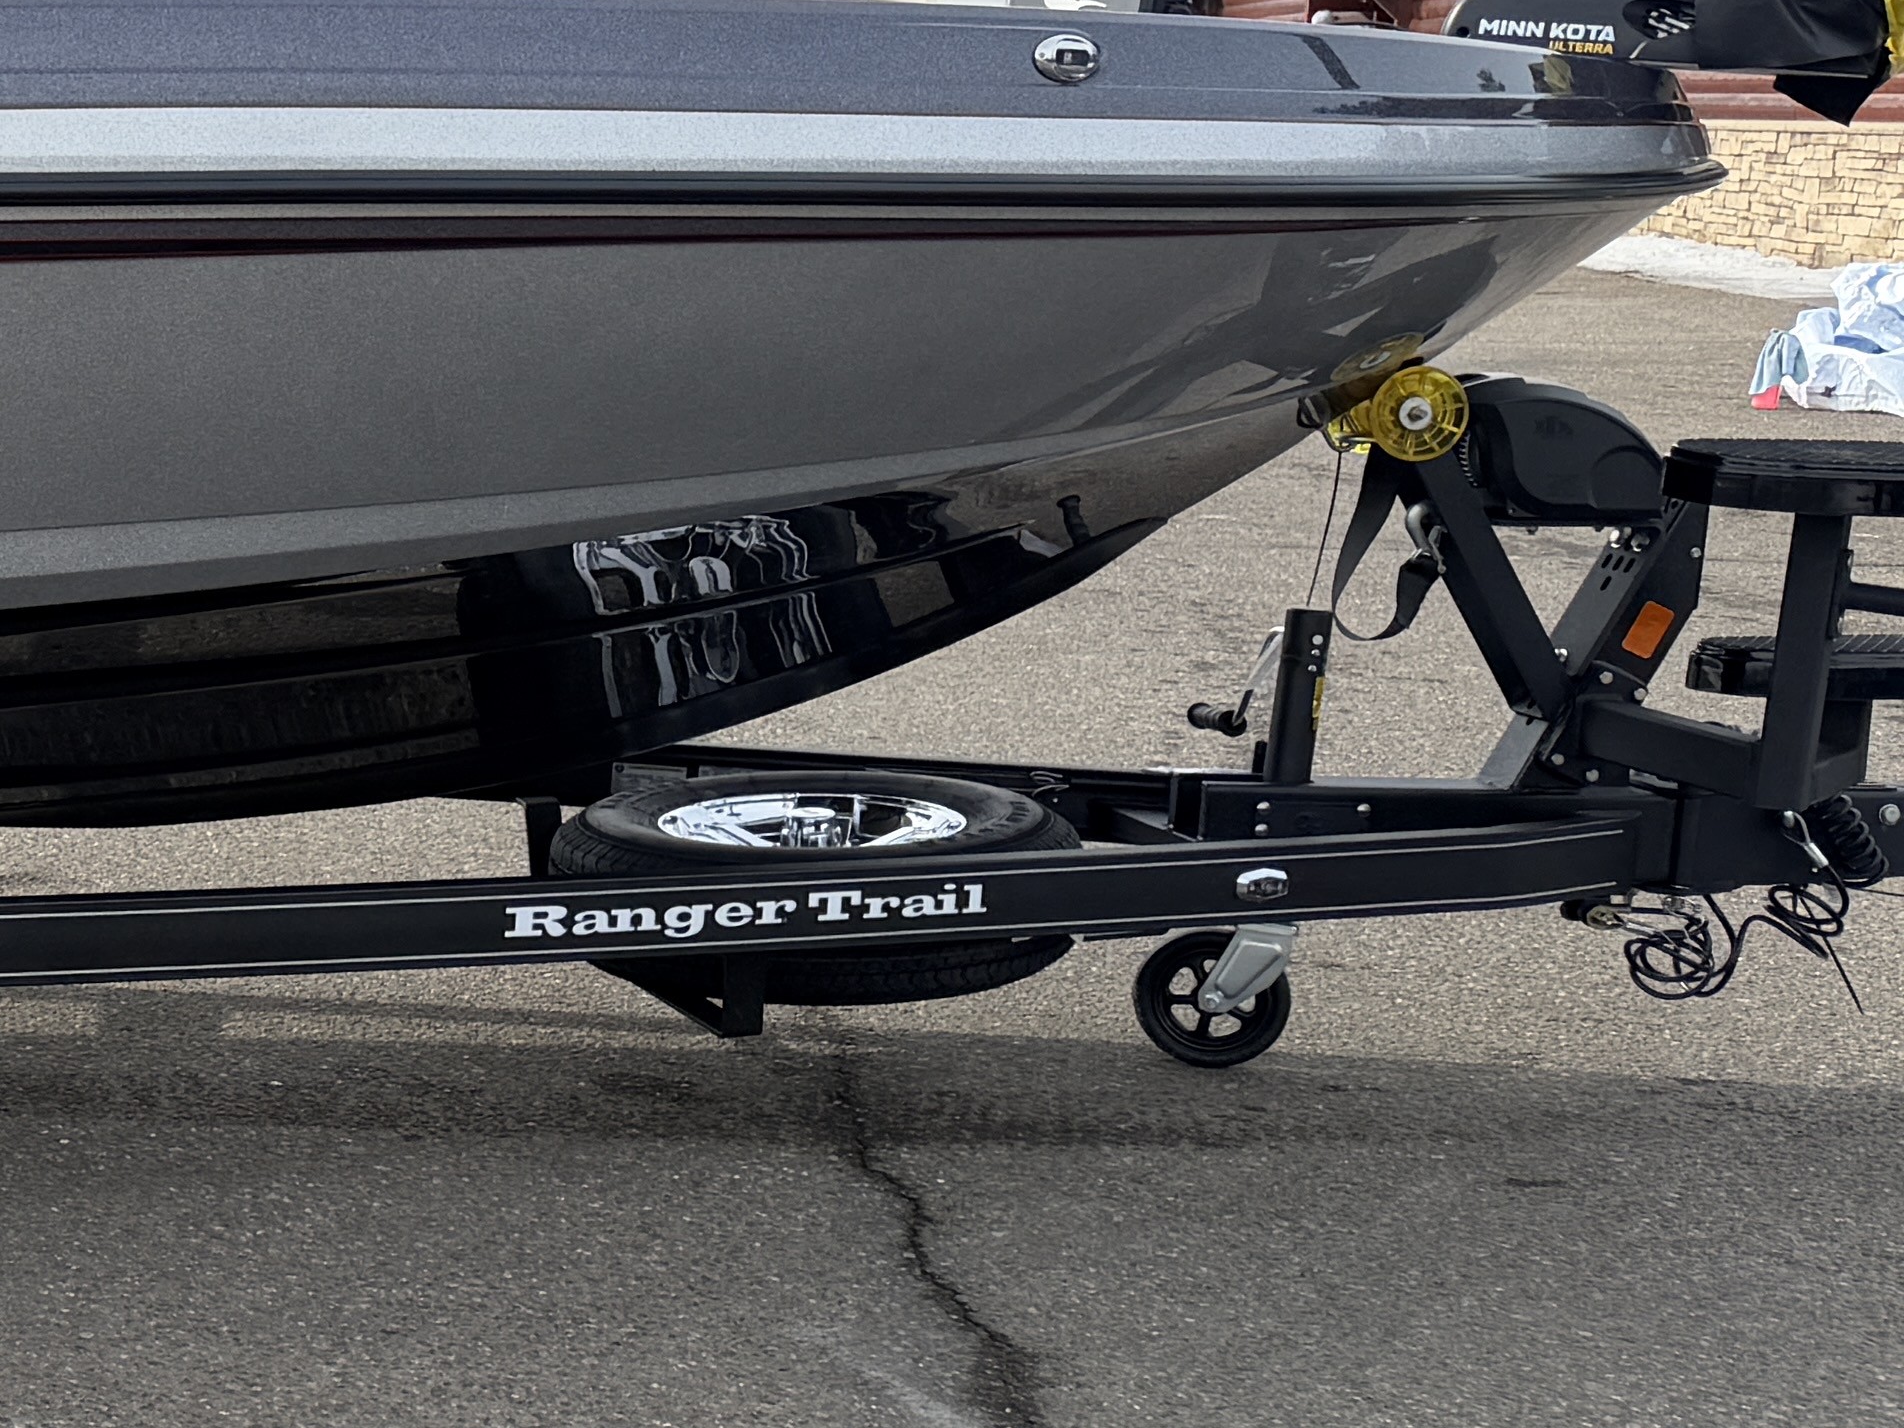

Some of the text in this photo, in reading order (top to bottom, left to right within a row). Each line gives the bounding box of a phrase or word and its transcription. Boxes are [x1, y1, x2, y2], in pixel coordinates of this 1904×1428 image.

[1478, 18, 1615, 42] MINN KOTA
[1549, 40, 1614, 54] ULTERRA
[504, 883, 987, 938] Ranger Trail
